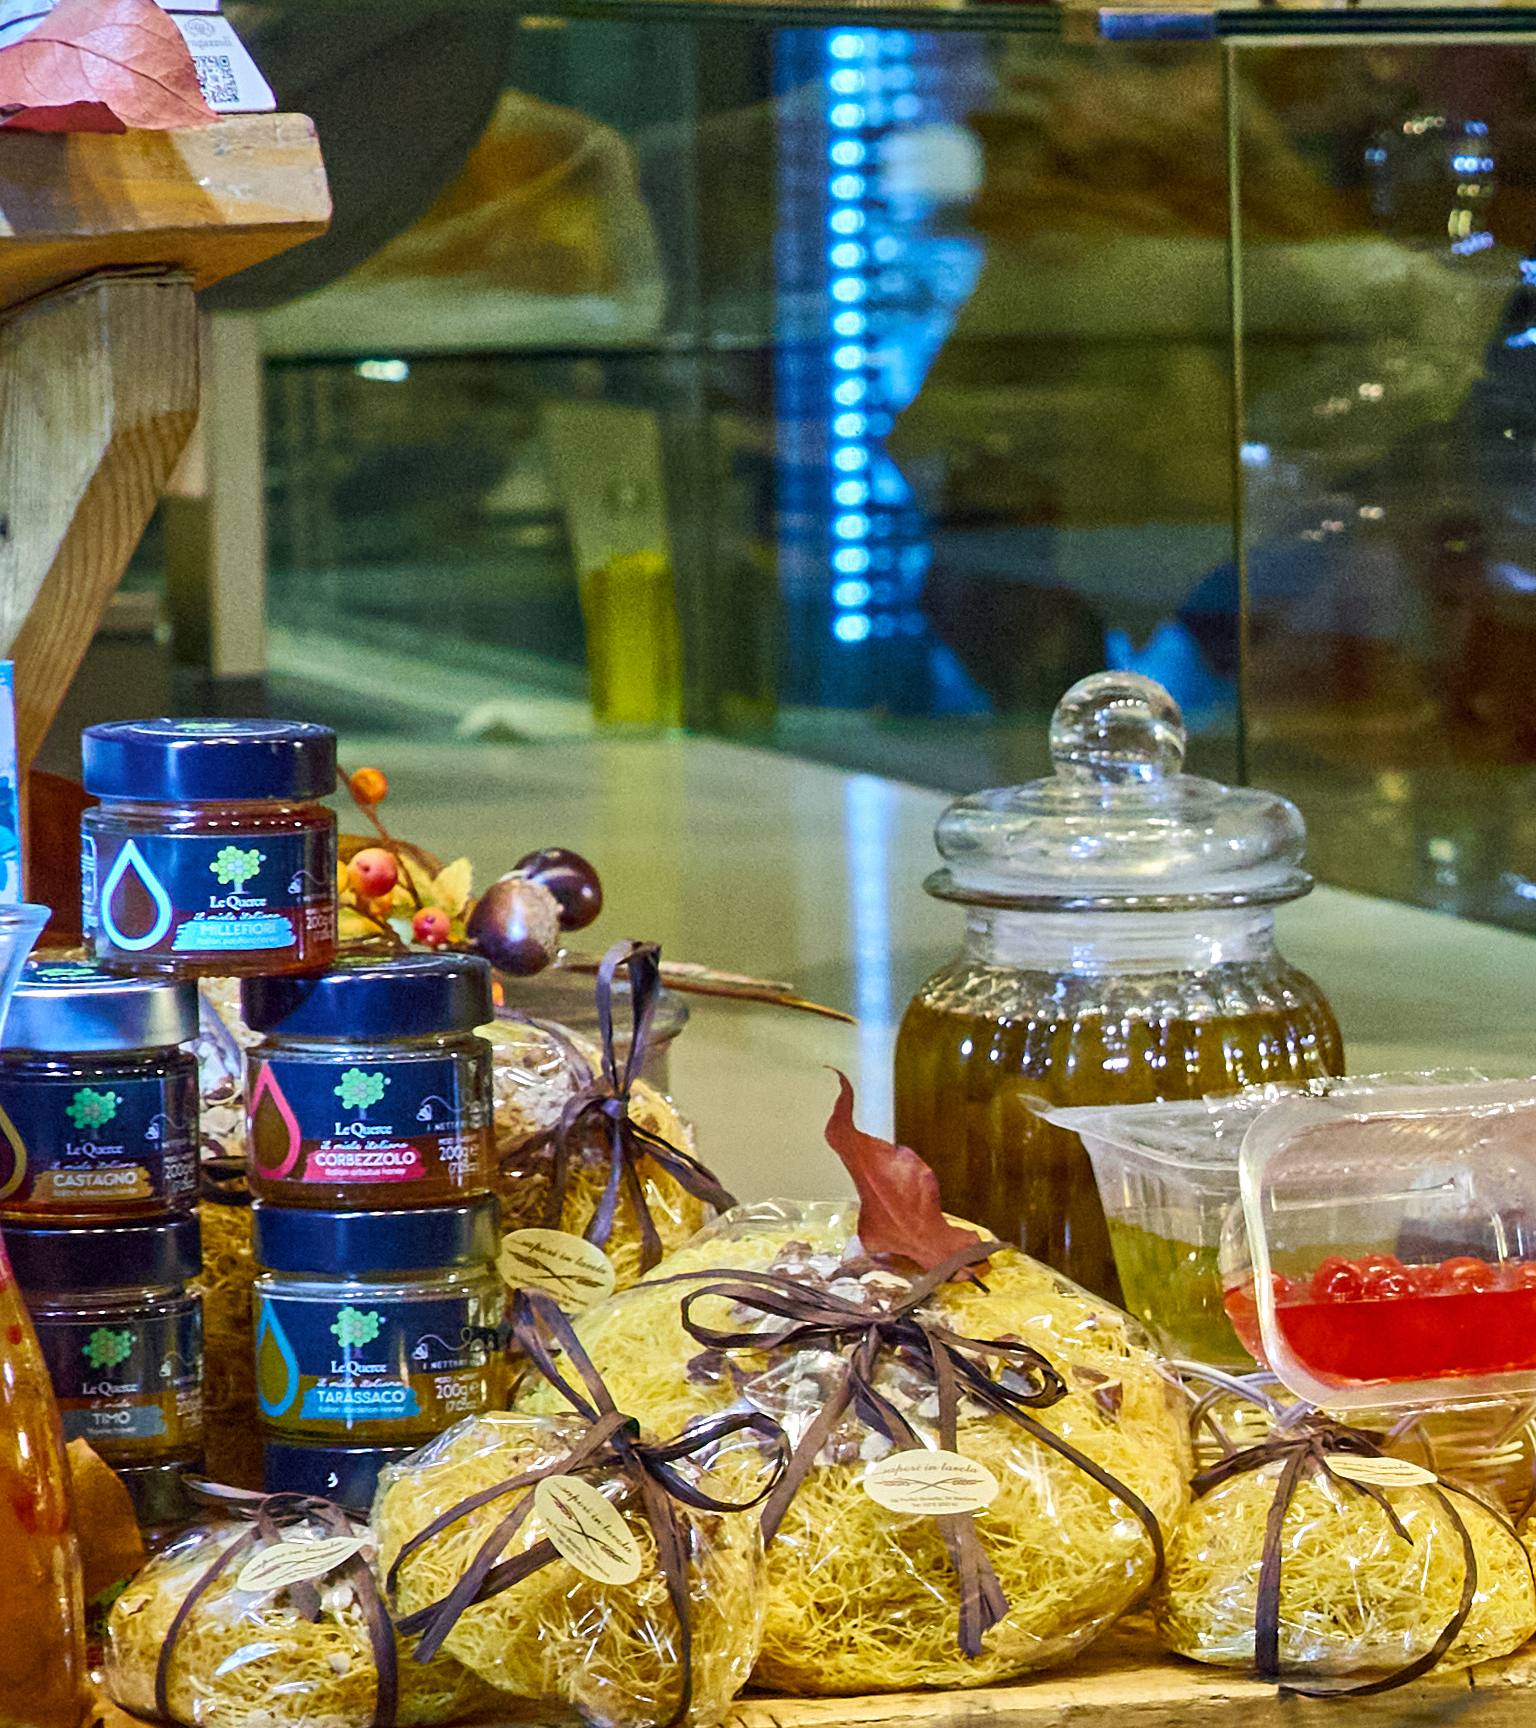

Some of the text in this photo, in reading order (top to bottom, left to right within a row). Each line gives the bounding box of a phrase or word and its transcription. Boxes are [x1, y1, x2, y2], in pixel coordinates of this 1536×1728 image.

[209, 895, 268, 911] Le Querce
[199, 923, 277, 936] MILLEFIORI
[334, 1121, 393, 1139] Le Querce
[65, 1142, 124, 1159] Le Querce
[438, 1144, 469, 1164] 200g
[314, 1151, 417, 1167] CORBEZZOLO
[52, 1171, 138, 1188] CASTAGNO
[330, 1360, 388, 1377] Le Querce
[81, 1382, 98, 1395] Le
[434, 1383, 468, 1402] 200g
[316, 1390, 407, 1404] TARASSACO
[91, 1410, 132, 1426] TIMO
[923, 1463, 937, 1472] in
